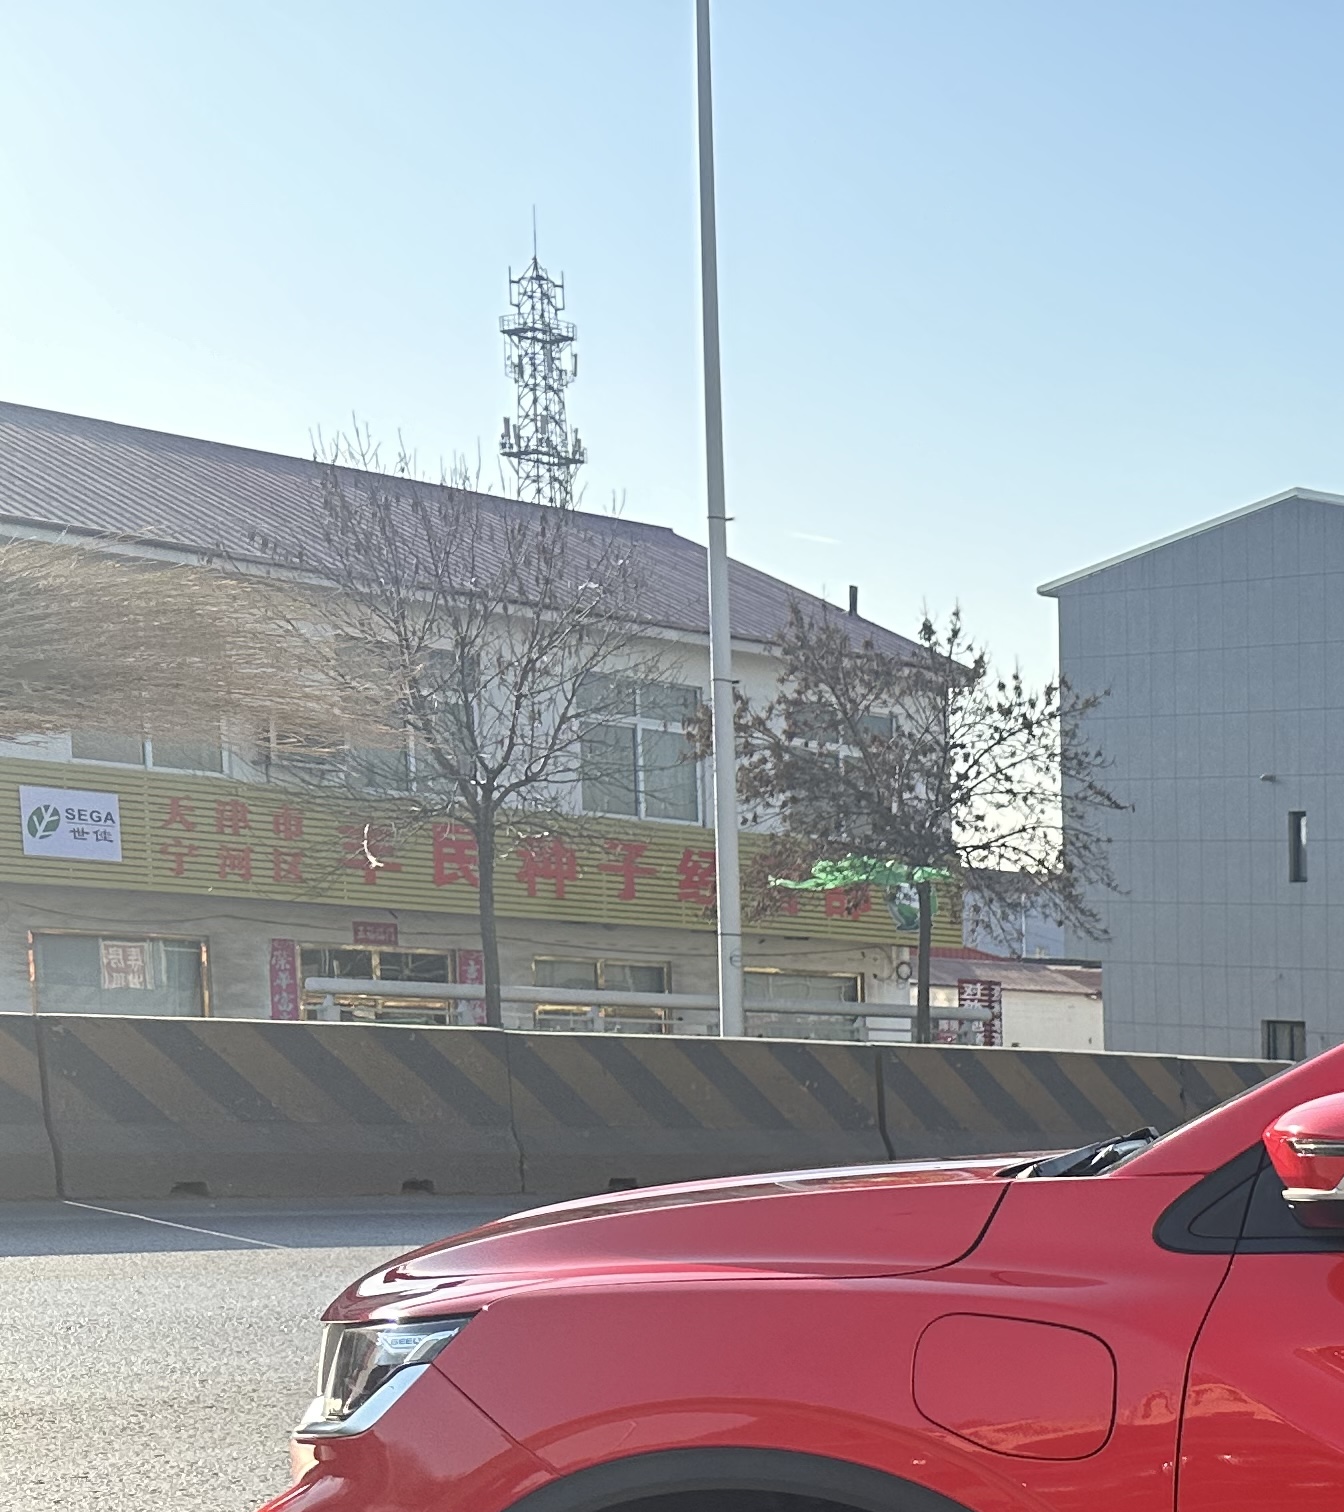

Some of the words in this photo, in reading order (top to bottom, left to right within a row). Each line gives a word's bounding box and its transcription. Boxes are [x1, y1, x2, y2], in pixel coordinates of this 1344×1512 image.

[65, 807, 116, 825] SEGA
[161, 795, 304, 840] 天津市
[160, 839, 305, 882] 宁河区
